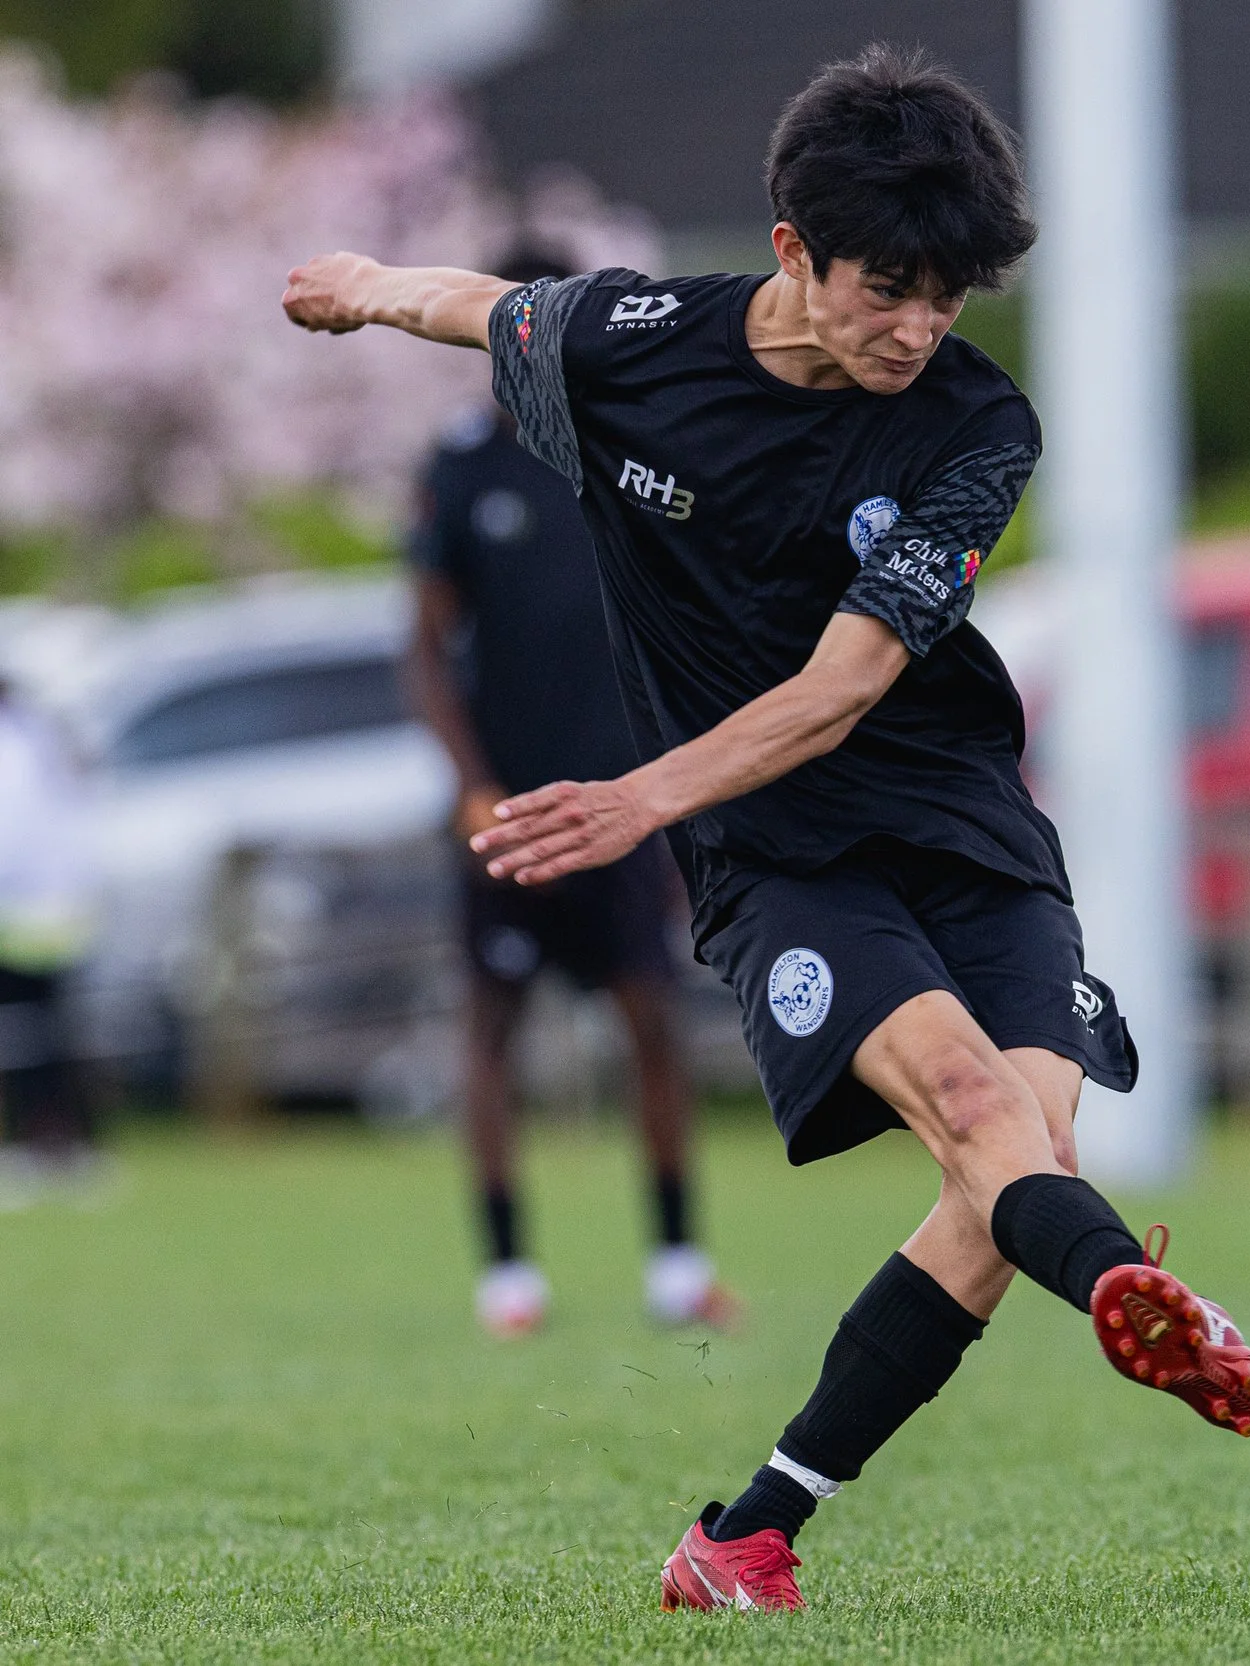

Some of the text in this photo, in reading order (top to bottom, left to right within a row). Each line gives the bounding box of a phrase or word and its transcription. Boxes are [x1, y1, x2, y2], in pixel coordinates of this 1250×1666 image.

[605, 320, 678, 331] DYNASTY
[618, 458, 695, 521] RH3
[862, 499, 899, 521] HAMILTN
[771, 952, 800, 992] HAMILTON
[795, 986, 829, 1032] WANDERERS
